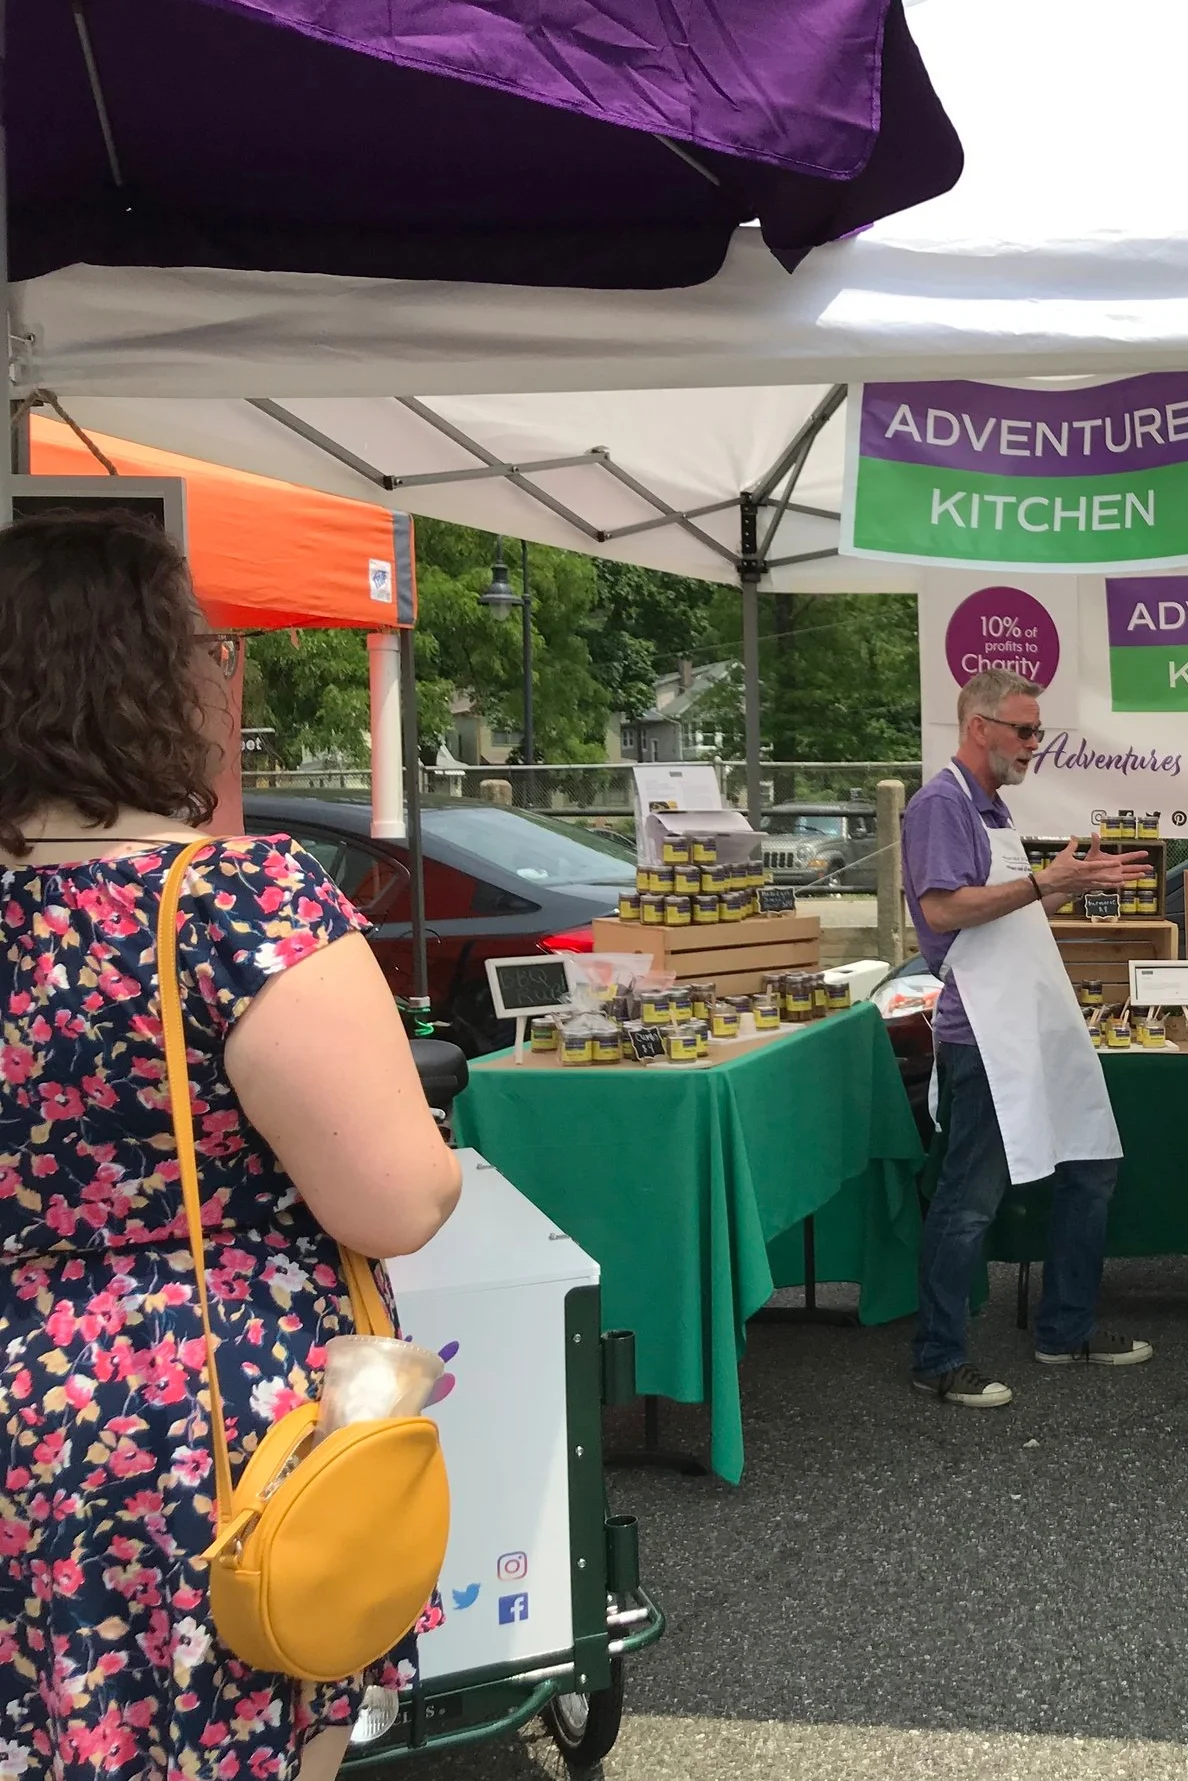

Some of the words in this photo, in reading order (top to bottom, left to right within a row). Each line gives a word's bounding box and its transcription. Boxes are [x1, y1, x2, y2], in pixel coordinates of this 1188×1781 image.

[930, 487, 1155, 532] KITCHEN
[980, 615, 1022, 638] 10%
[1024, 626, 1038, 638] of
[984, 640, 1023, 653] profits
[1025, 641, 1038, 653] to
[961, 653, 1040, 680] Charity
[1032, 731, 1183, 777] Adventures
